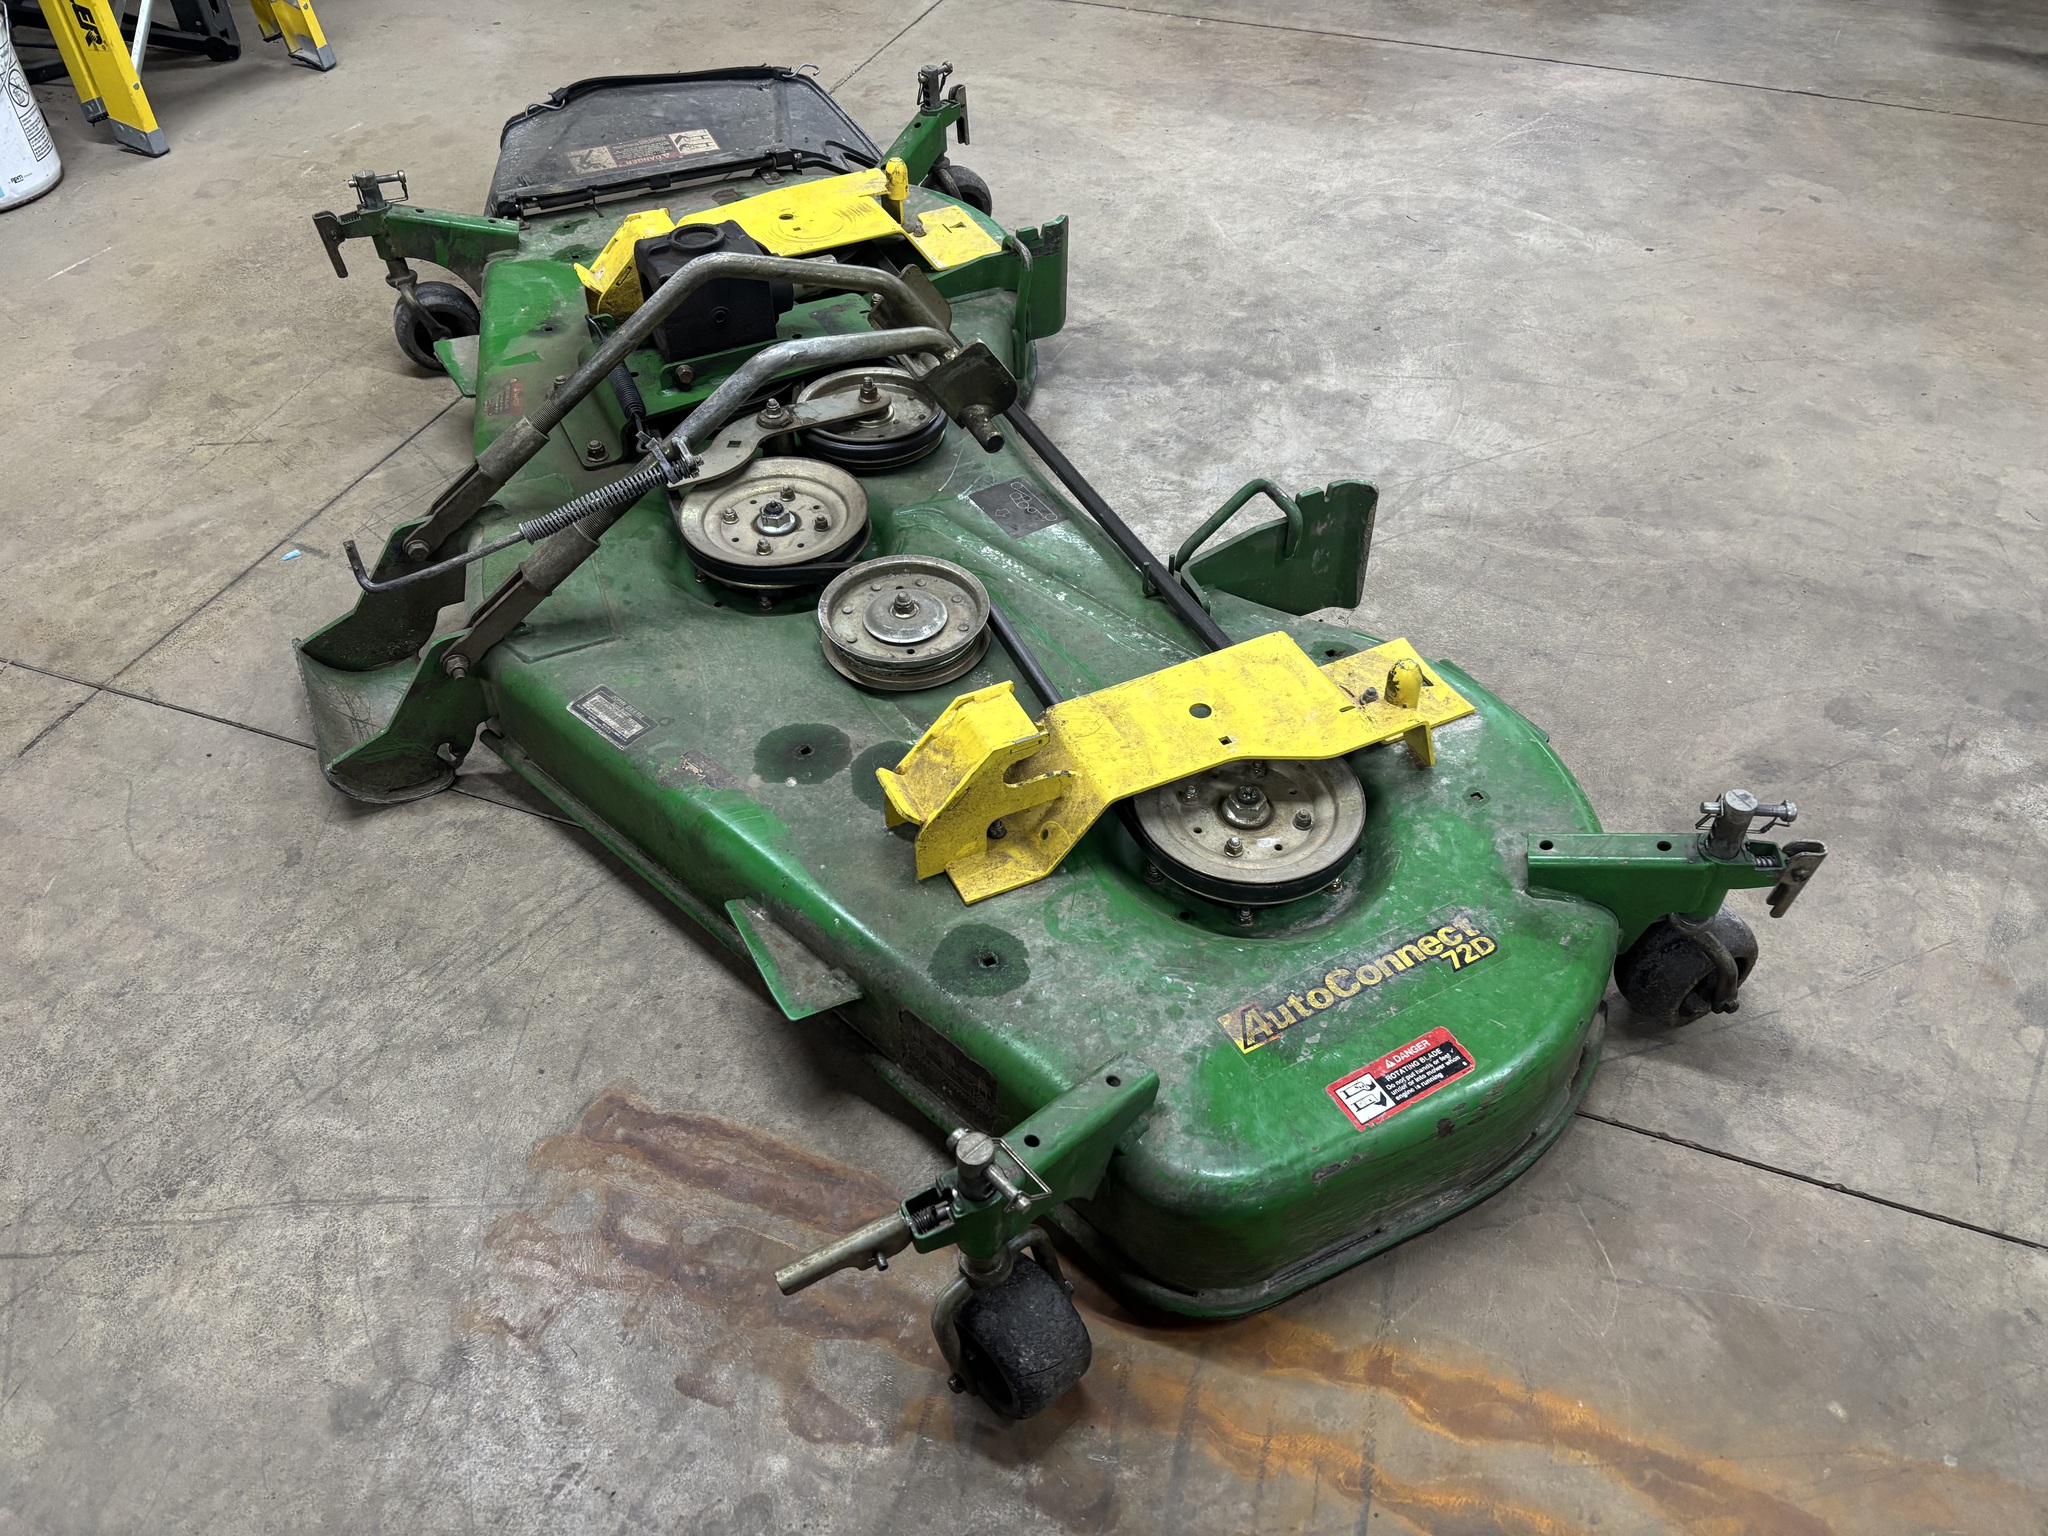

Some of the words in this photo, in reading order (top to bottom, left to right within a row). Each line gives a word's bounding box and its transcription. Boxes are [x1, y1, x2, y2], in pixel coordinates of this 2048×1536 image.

[69, 0, 103, 47] ER
[1439, 935, 1496, 971] 72D
[1243, 916, 1481, 1044] AutoConnect
[1385, 1060, 1420, 1081] ROTATING
[1420, 1048, 1442, 1062] BLADE
[1393, 1040, 1431, 1063] DANGER
[1391, 1084, 1408, 1096] under
[1415, 1073, 1426, 1082] into
[1427, 1064, 1445, 1077] mower
[1395, 1077, 1406, 1086] not
[1406, 1071, 1416, 1082] put
[1416, 1063, 1433, 1074] hands
[1441, 1053, 1451, 1063] feet
[1395, 1089, 1415, 1101] engine
[1421, 1073, 1444, 1087] running
